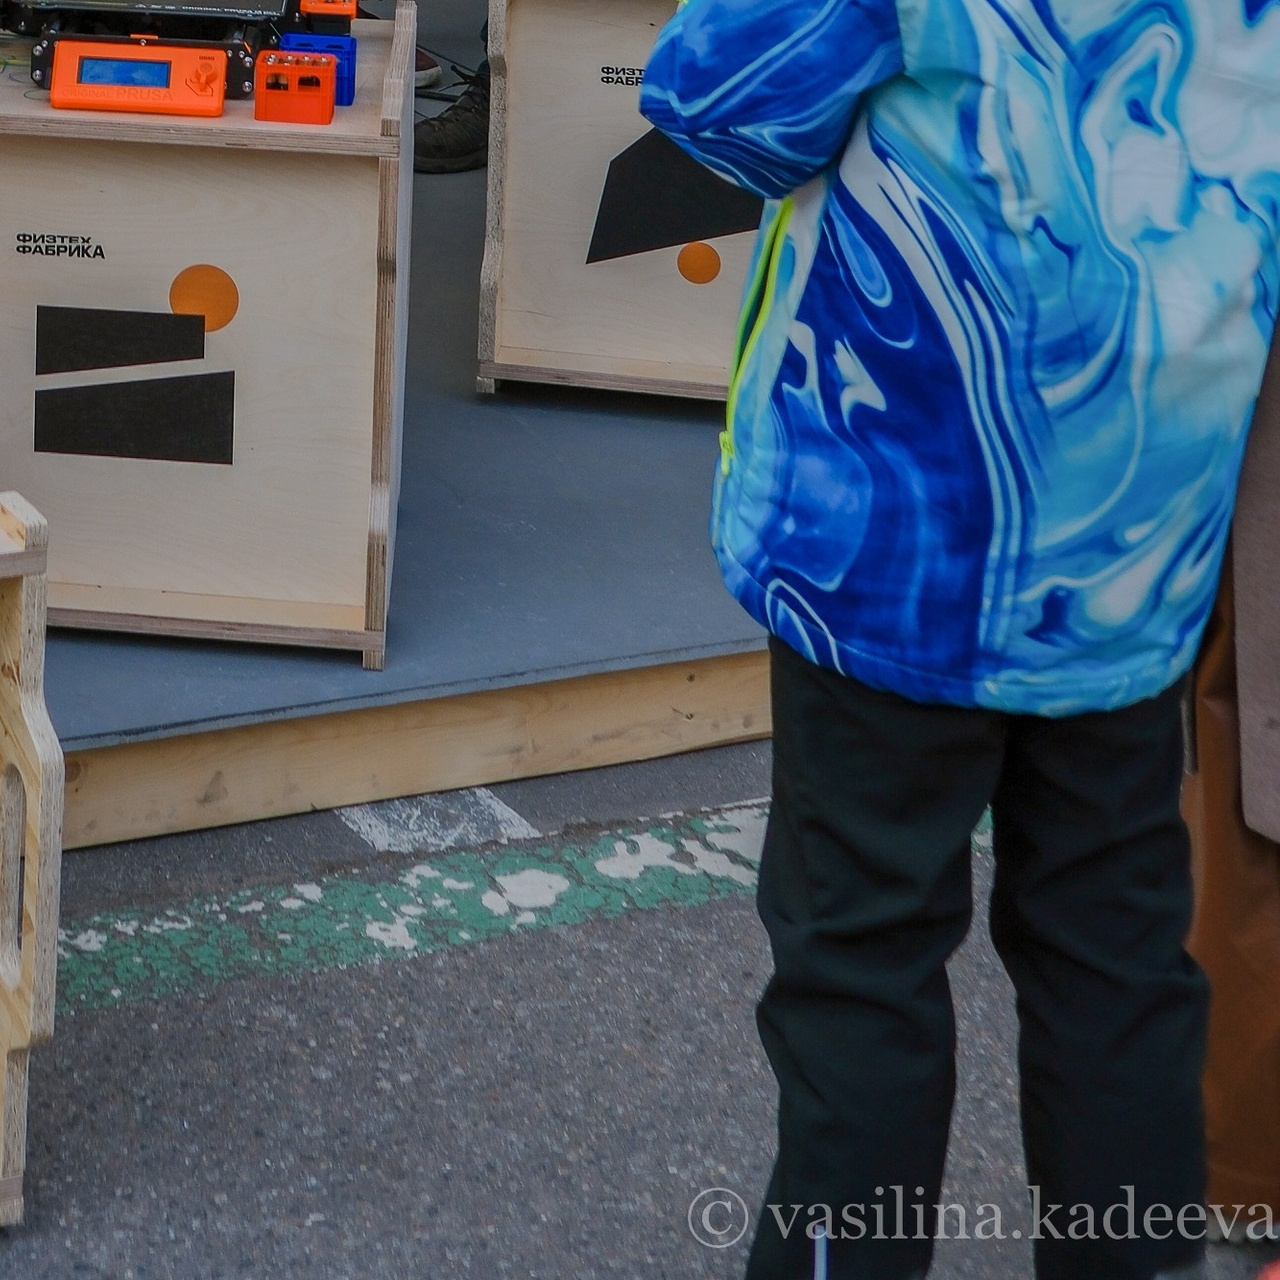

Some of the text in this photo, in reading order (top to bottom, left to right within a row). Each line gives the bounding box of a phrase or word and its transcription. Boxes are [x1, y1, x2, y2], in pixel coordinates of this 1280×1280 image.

[601, 66, 646, 76] ФИЗТ
[601, 76, 643, 86] ФАБР
[117, 87, 174, 101] PRUSA
[16, 234, 91, 244] ФИЗТЕХ
[16, 245, 105, 259] ФАБРИКА
